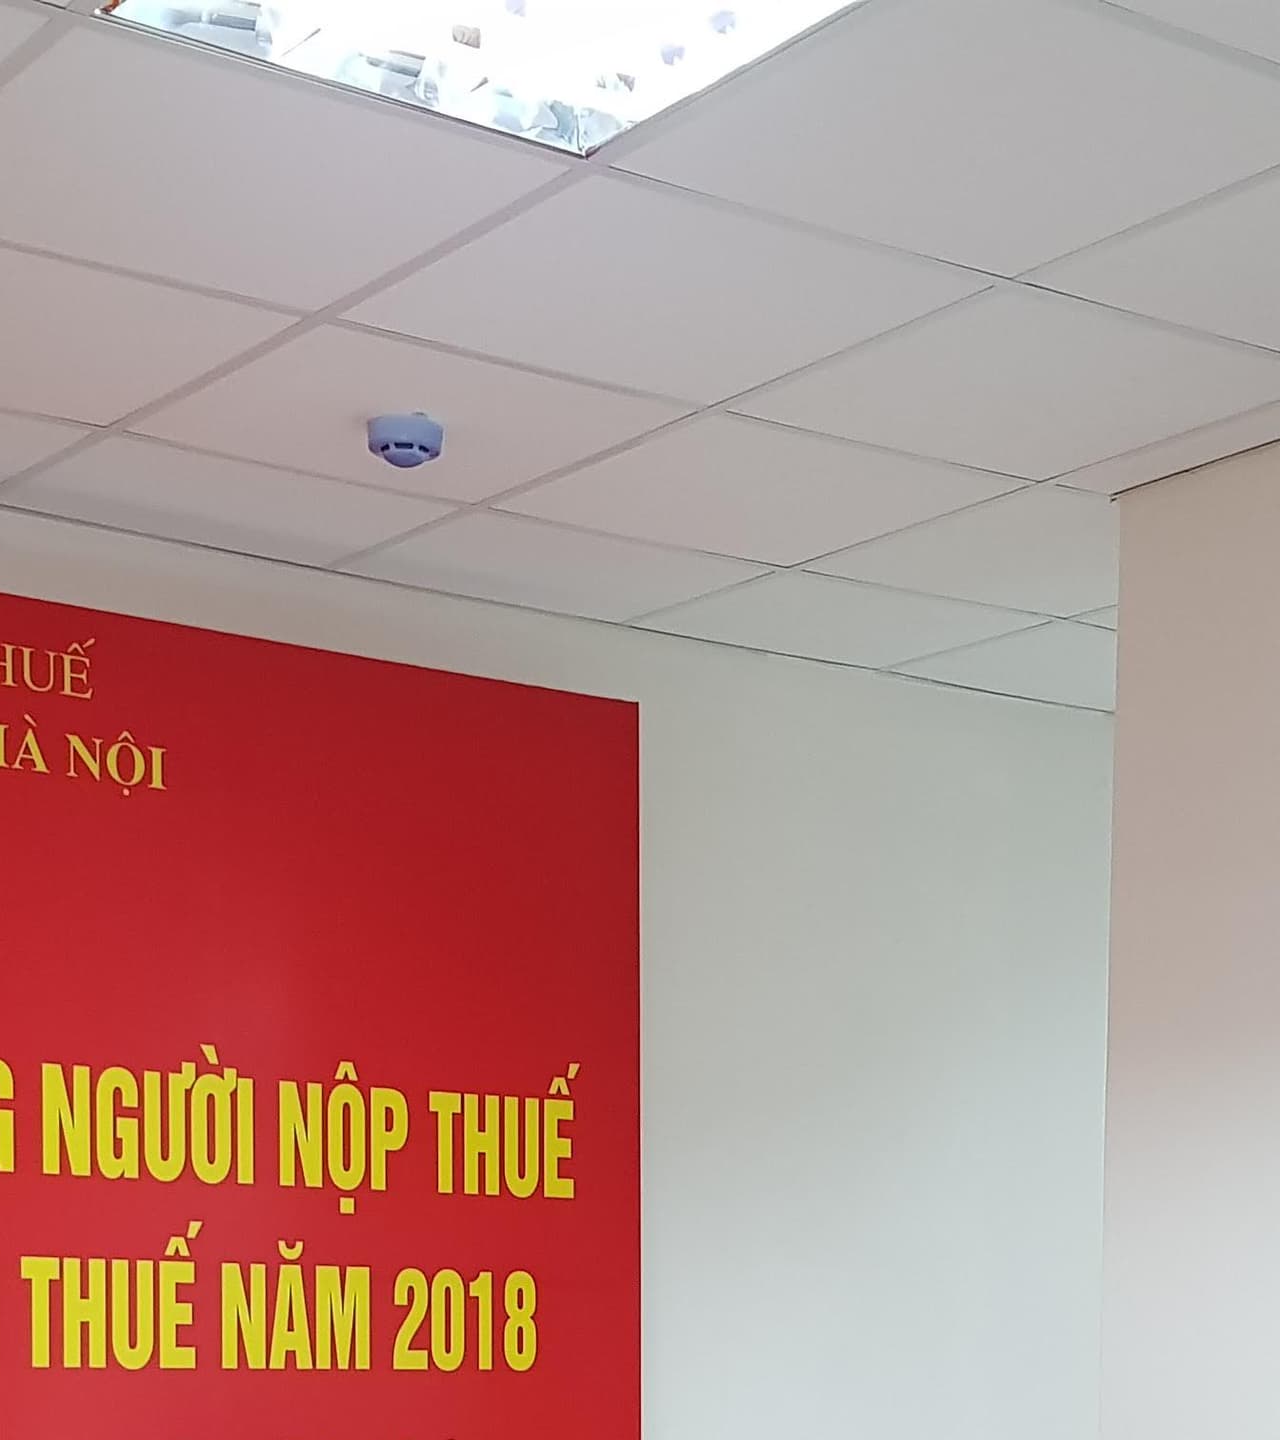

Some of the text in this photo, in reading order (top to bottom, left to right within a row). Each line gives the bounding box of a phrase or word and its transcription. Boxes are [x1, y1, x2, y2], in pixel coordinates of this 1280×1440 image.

[64, 730, 168, 796] NỘI
[40, 1044, 255, 1186] NGƯỜI
[278, 1061, 409, 1216] NỘP
[429, 1063, 580, 1200] THUẾ
[19, 1221, 204, 1372] THUẾ
[220, 1241, 372, 1372] NĂM
[392, 1268, 538, 1373] 2018
